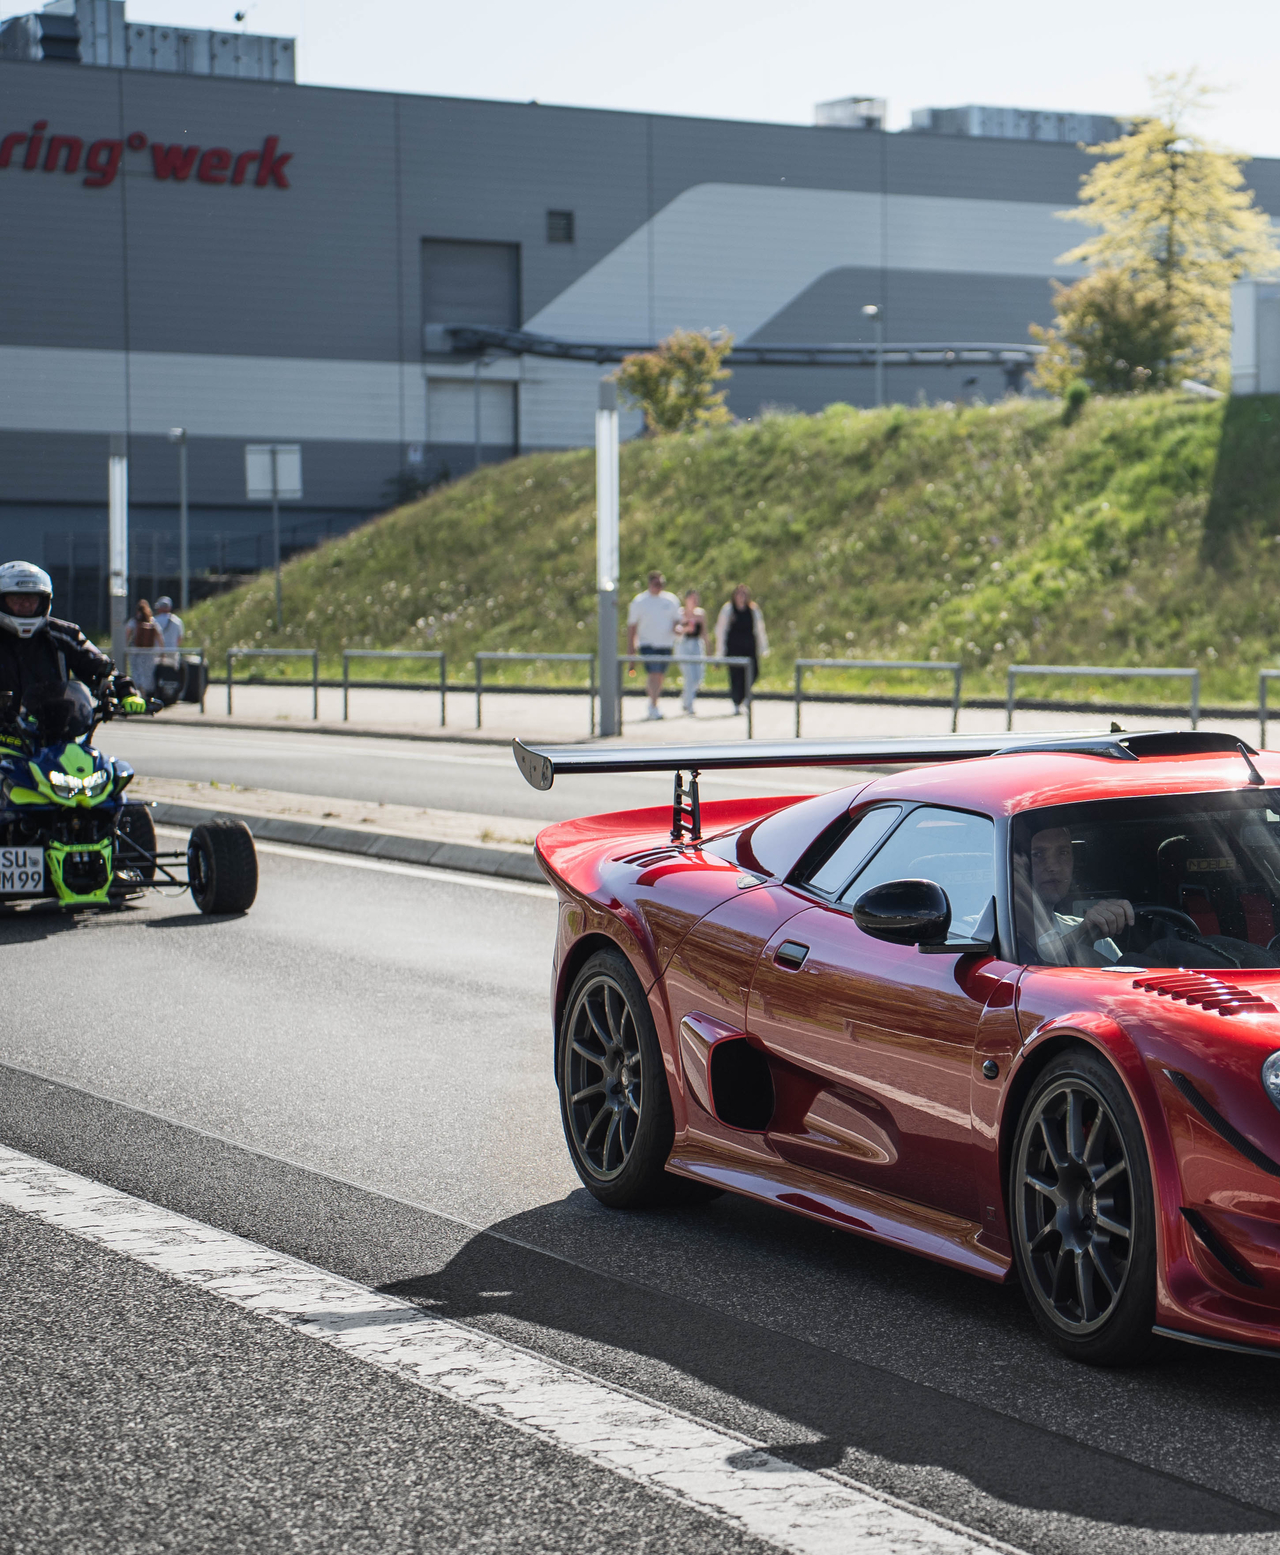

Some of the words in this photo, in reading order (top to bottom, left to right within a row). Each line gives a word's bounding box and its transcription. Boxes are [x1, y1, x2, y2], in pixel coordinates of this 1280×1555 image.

[2, 850, 27, 868] SU
[1189, 859, 1234, 870] NOBLE
[0, 870, 14, 889] M
[18, 870, 42, 889] 99
